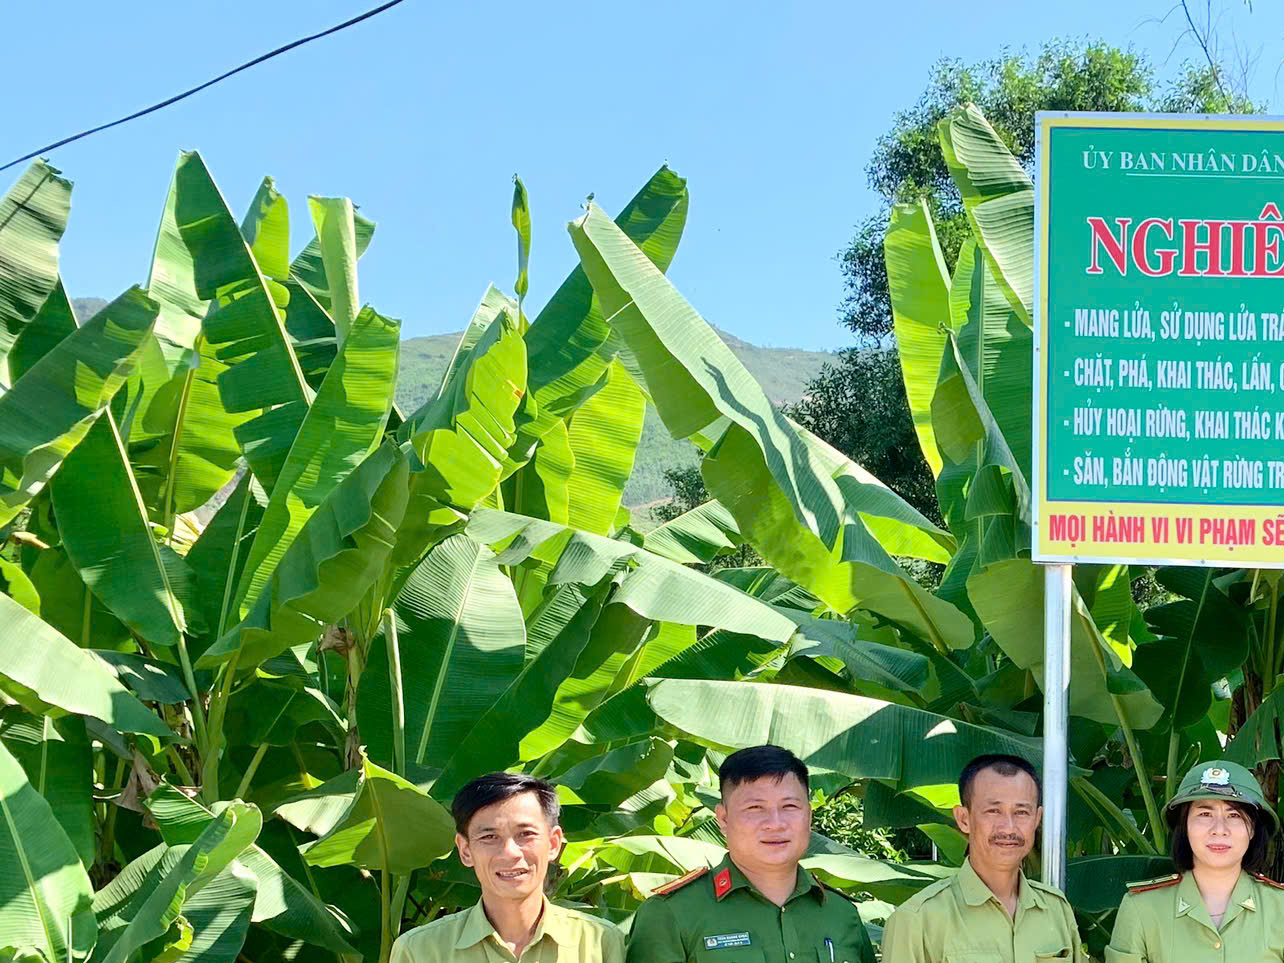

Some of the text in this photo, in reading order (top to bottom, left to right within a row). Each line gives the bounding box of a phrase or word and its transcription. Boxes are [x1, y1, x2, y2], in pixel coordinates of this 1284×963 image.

[1082, 145, 1114, 169] ỦY
[1120, 151, 1165, 171] BAN
[1172, 148, 1235, 172] NHÂN
[1074, 308, 1119, 337] MANG
[1123, 300, 1155, 342] LỬA,
[1160, 301, 1181, 340] SỬ
[1184, 311, 1225, 346] DỤNG
[1229, 303, 1257, 341] LỬA
[1074, 352, 1114, 393] CHẶT,
[1119, 354, 1153, 391] PHÁ,
[1157, 360, 1192, 389] KHAI
[1196, 355, 1238, 393] THÁC,
[1242, 352, 1275, 394] LẤN,
[1073, 398, 1103, 436] HỦY
[1107, 408, 1141, 443] HOẠI
[1145, 403, 1191, 441] RỪNG,
[1195, 411, 1230, 439] KHAI
[1233, 405, 1271, 440] THÁC
[1073, 450, 1109, 488] SĂN,
[1112, 447, 1143, 486] BẮN
[1147, 452, 1188, 493] ĐỘNG
[1192, 454, 1219, 494] VẬT
[1223, 454, 1263, 489] RỪNG
[1049, 514, 1086, 548] MỌI
[1092, 510, 1145, 543] HÀNH
[1151, 517, 1169, 544] VI
[1175, 517, 1193, 544] VI
[1199, 518, 1256, 551] PHẠM
